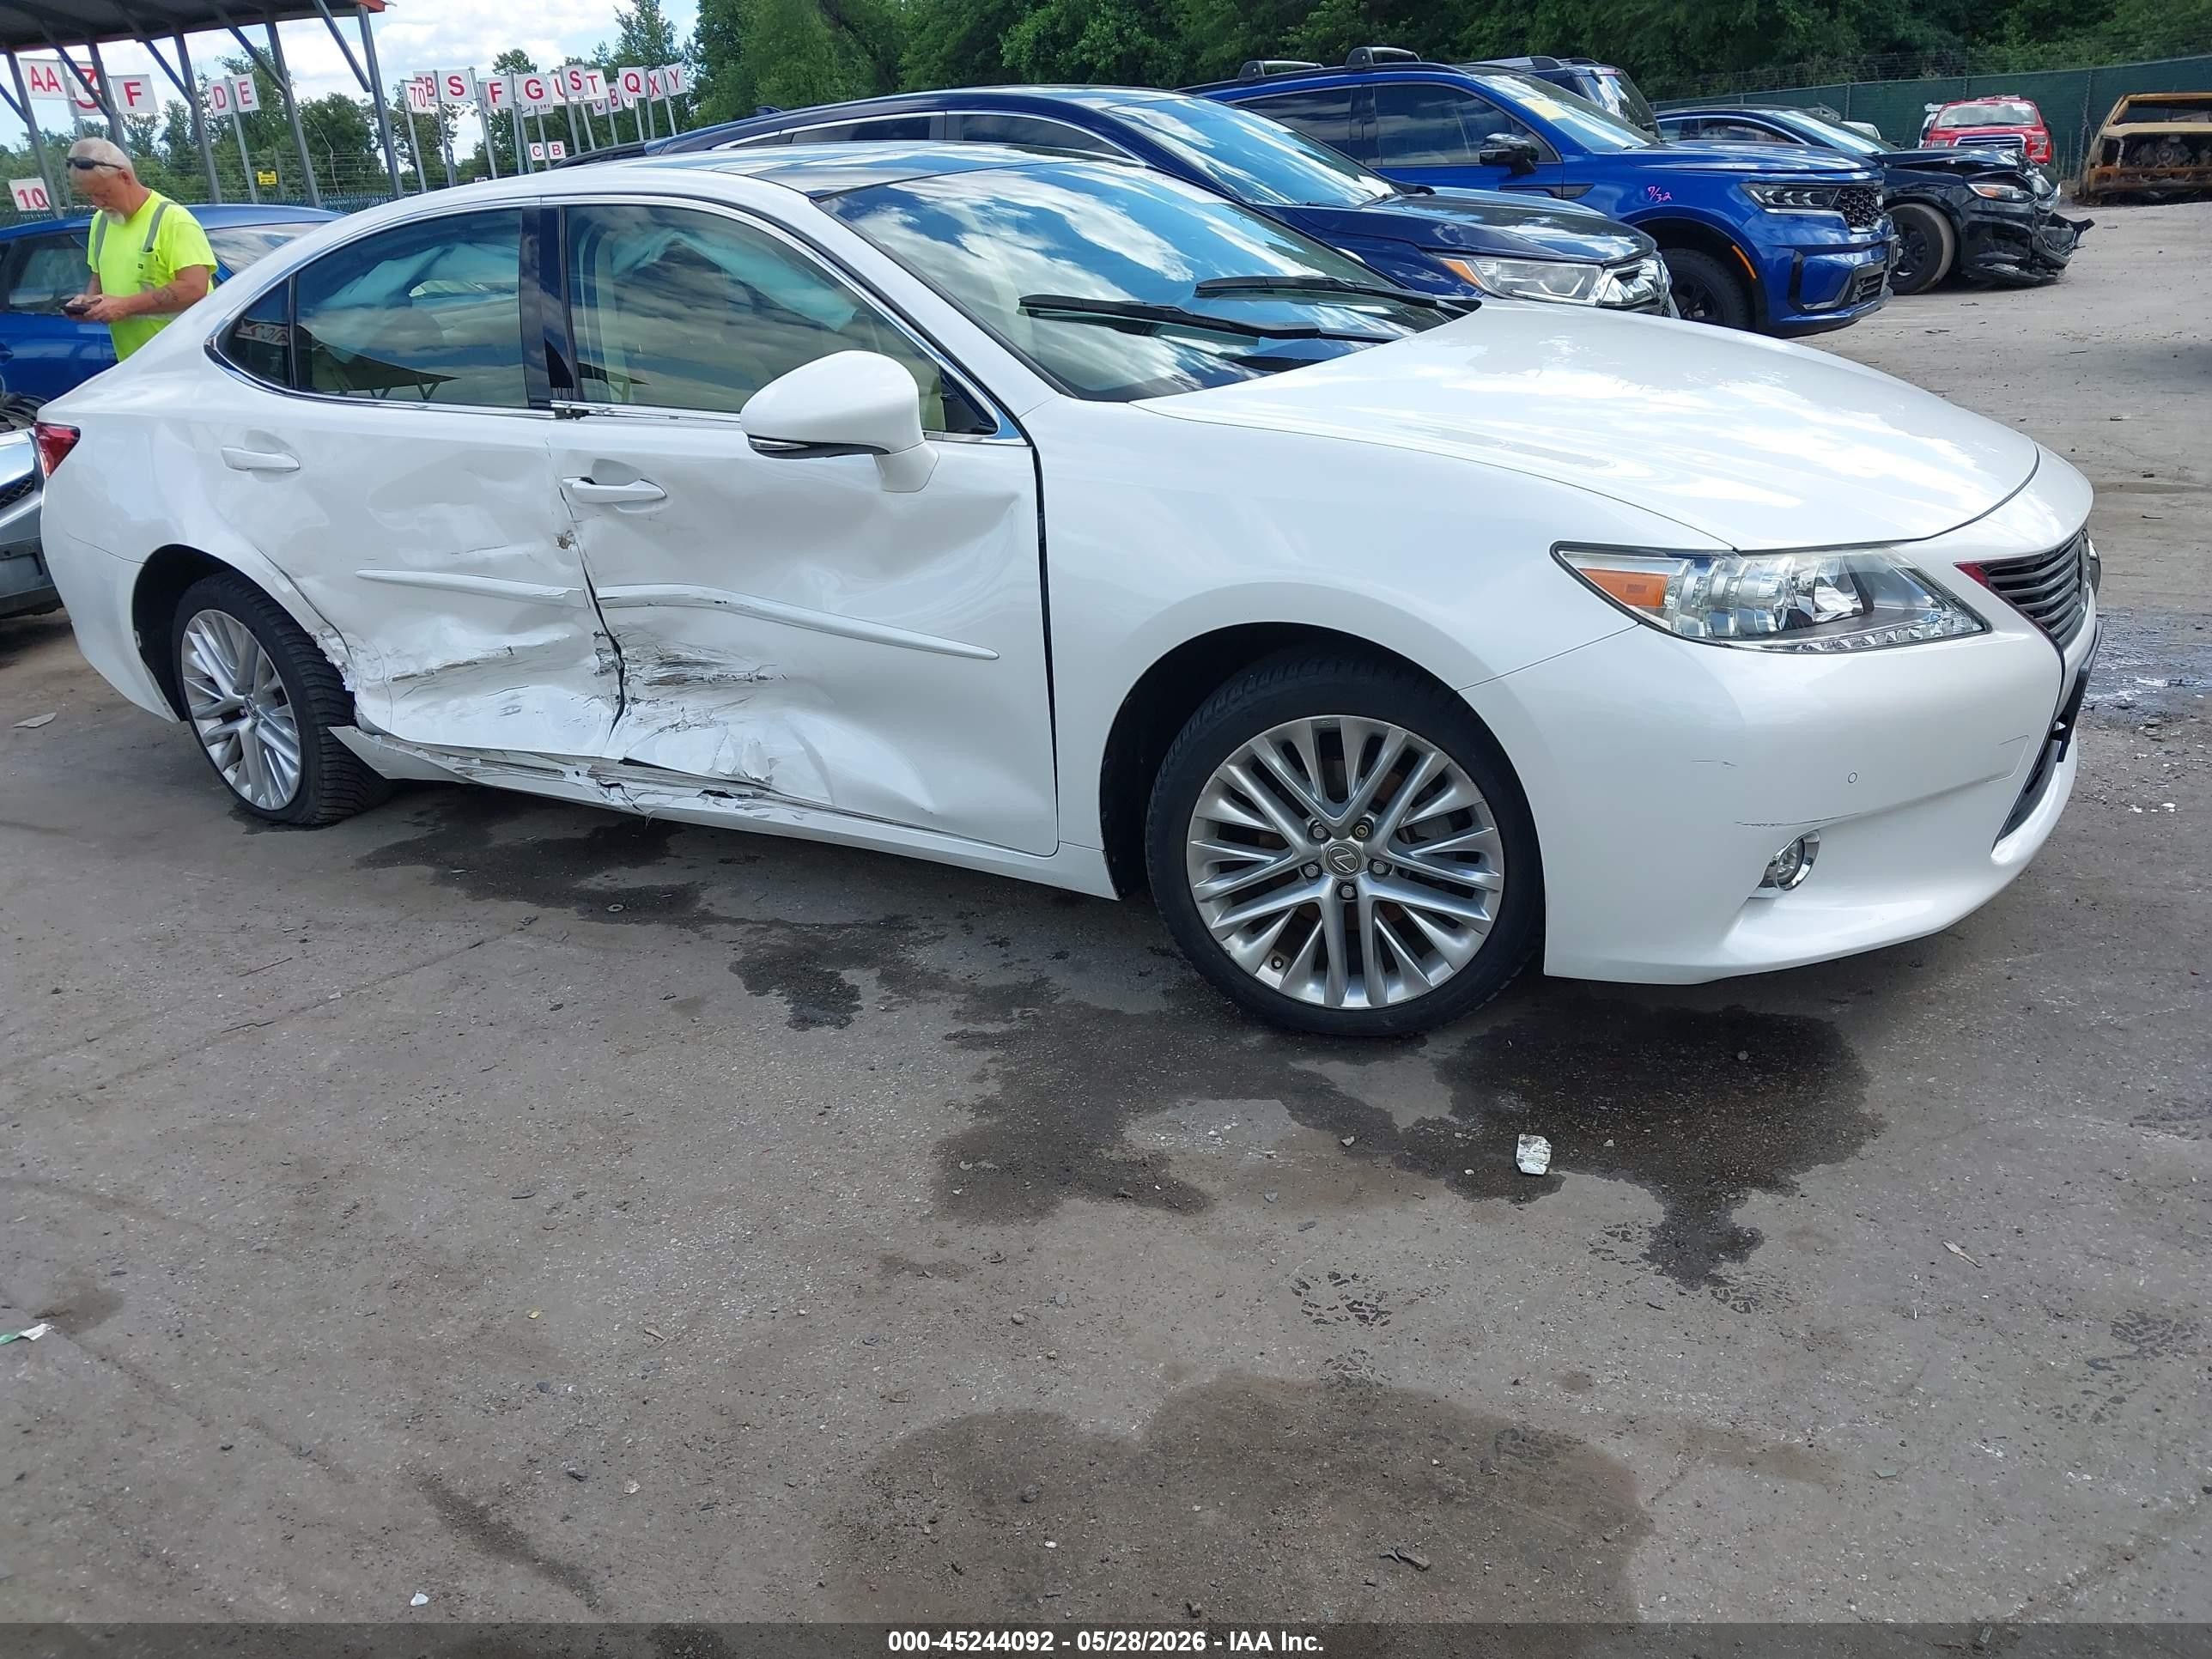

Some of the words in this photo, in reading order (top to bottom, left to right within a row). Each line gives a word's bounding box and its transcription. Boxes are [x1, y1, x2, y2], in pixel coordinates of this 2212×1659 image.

[31, 65, 62, 92] AA
[447, 76, 465, 96] S
[569, 70, 582, 91] S
[586, 75, 598, 94] T
[624, 72, 641, 94] Q
[648, 75, 660, 96] X
[669, 69, 679, 89] Y
[124, 82, 142, 107] F
[213, 85, 227, 109] D
[239, 81, 252, 105] E
[410, 87, 426, 107] 70
[489, 82, 502, 103] F
[525, 79, 544, 100] G
[609, 88, 618, 106] B
[532, 145, 542, 157] C
[551, 144, 562, 155] B
[17, 187, 46, 210] 10
